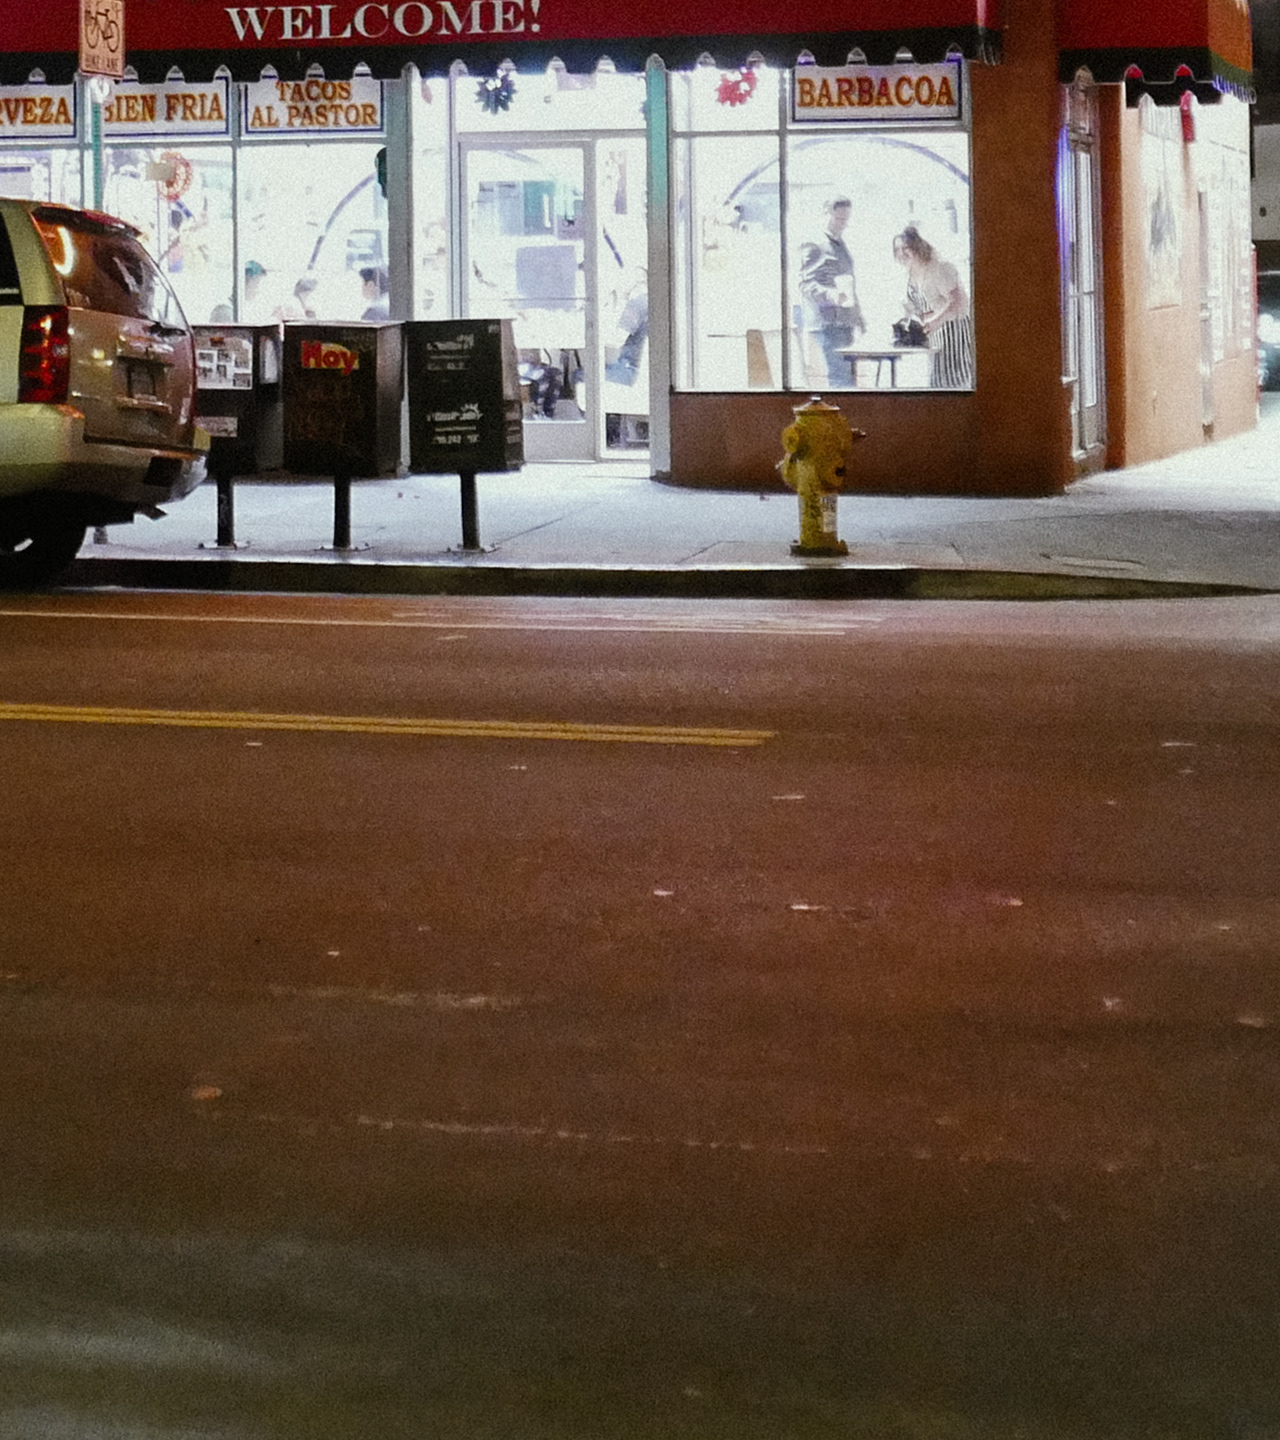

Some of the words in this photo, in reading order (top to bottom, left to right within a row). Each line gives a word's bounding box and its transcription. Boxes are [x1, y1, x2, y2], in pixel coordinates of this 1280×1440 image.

[275, 79, 352, 103] TACOS
[797, 74, 955, 108] BARBACOA
[165, 92, 223, 122] FRIA
[250, 105, 280, 129] AL
[286, 102, 378, 127] PASTOR
[301, 340, 359, 375] Hoy
